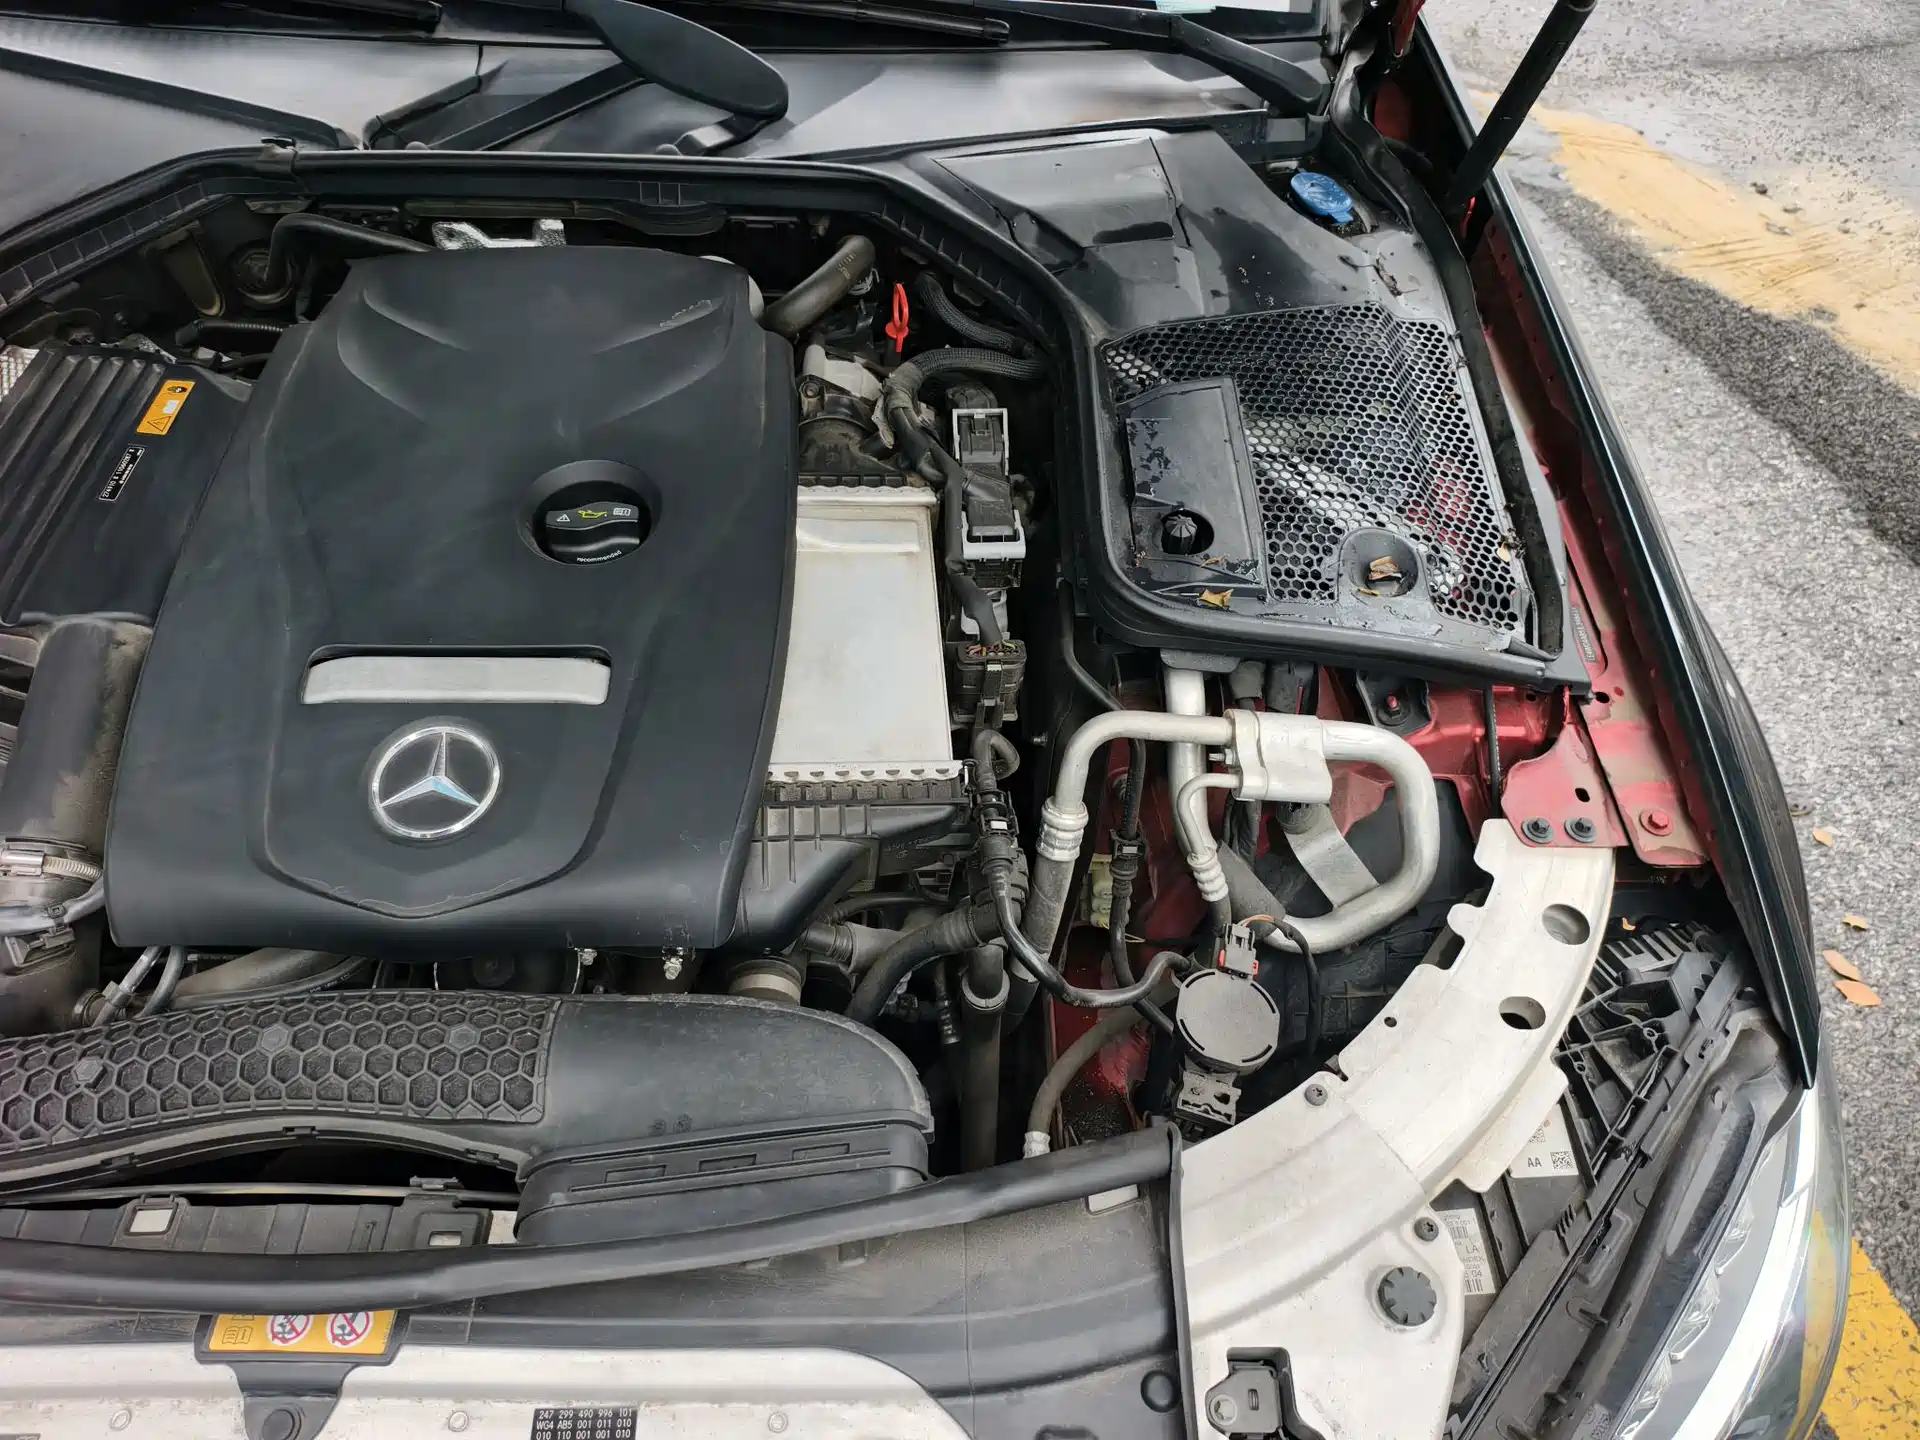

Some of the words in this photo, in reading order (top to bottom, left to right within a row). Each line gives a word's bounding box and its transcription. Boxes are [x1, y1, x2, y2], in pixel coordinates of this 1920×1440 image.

[576, 550, 621, 562] recommended
[1527, 1156, 1542, 1168] AA
[1465, 1244, 1479, 1254] LA
[539, 1410, 554, 1419] 247
[559, 1409, 573, 1419] 299
[578, 1409, 593, 1418] 490
[598, 1408, 613, 1418] 996
[619, 1408, 632, 1417] 101
[536, 1421, 554, 1430] WG4
[557, 1420, 573, 1429] AB5
[577, 1419, 592, 1429] 001
[596, 1419, 611, 1428] 011
[616, 1418, 632, 1427] 010
[535, 1431, 551, 1440] 010
[557, 1430, 572, 1440] 110
[575, 1430, 590, 1440] 001
[595, 1429, 610, 1439] 001
[615, 1429, 631, 1438] 010
